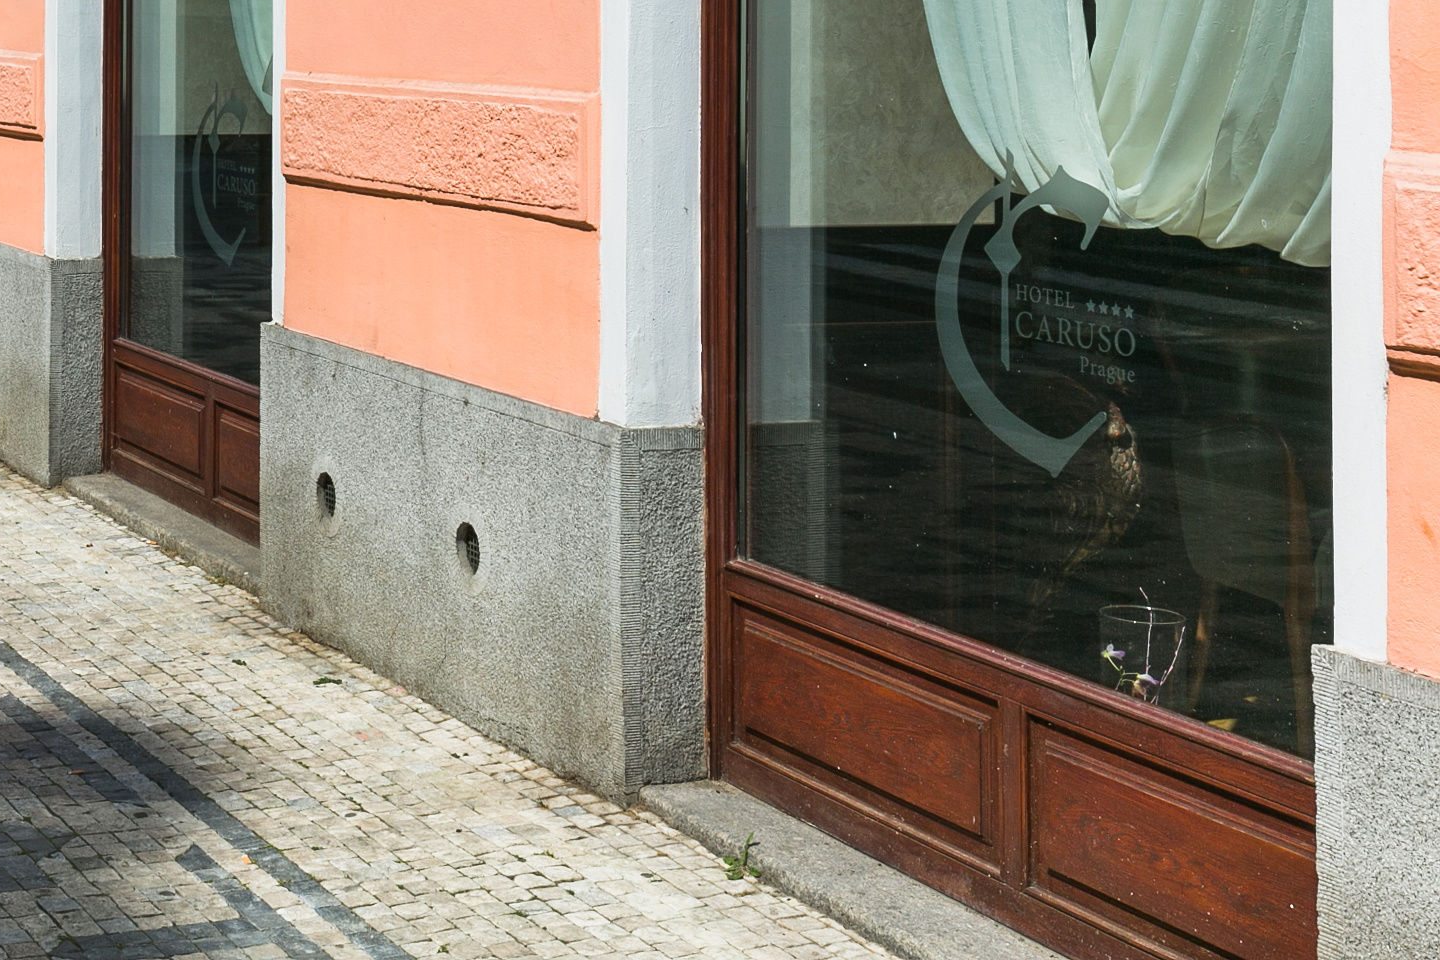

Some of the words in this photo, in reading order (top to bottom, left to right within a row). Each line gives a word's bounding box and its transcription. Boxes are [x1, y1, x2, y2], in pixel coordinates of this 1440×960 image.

[217, 158, 237, 171] HOTEL
[217, 173, 256, 196] CARUSO
[237, 196, 255, 212] Prague
[1015, 283, 1075, 309] HOTEL
[1015, 311, 1136, 357] CARUSO
[1079, 355, 1136, 385] Prague
